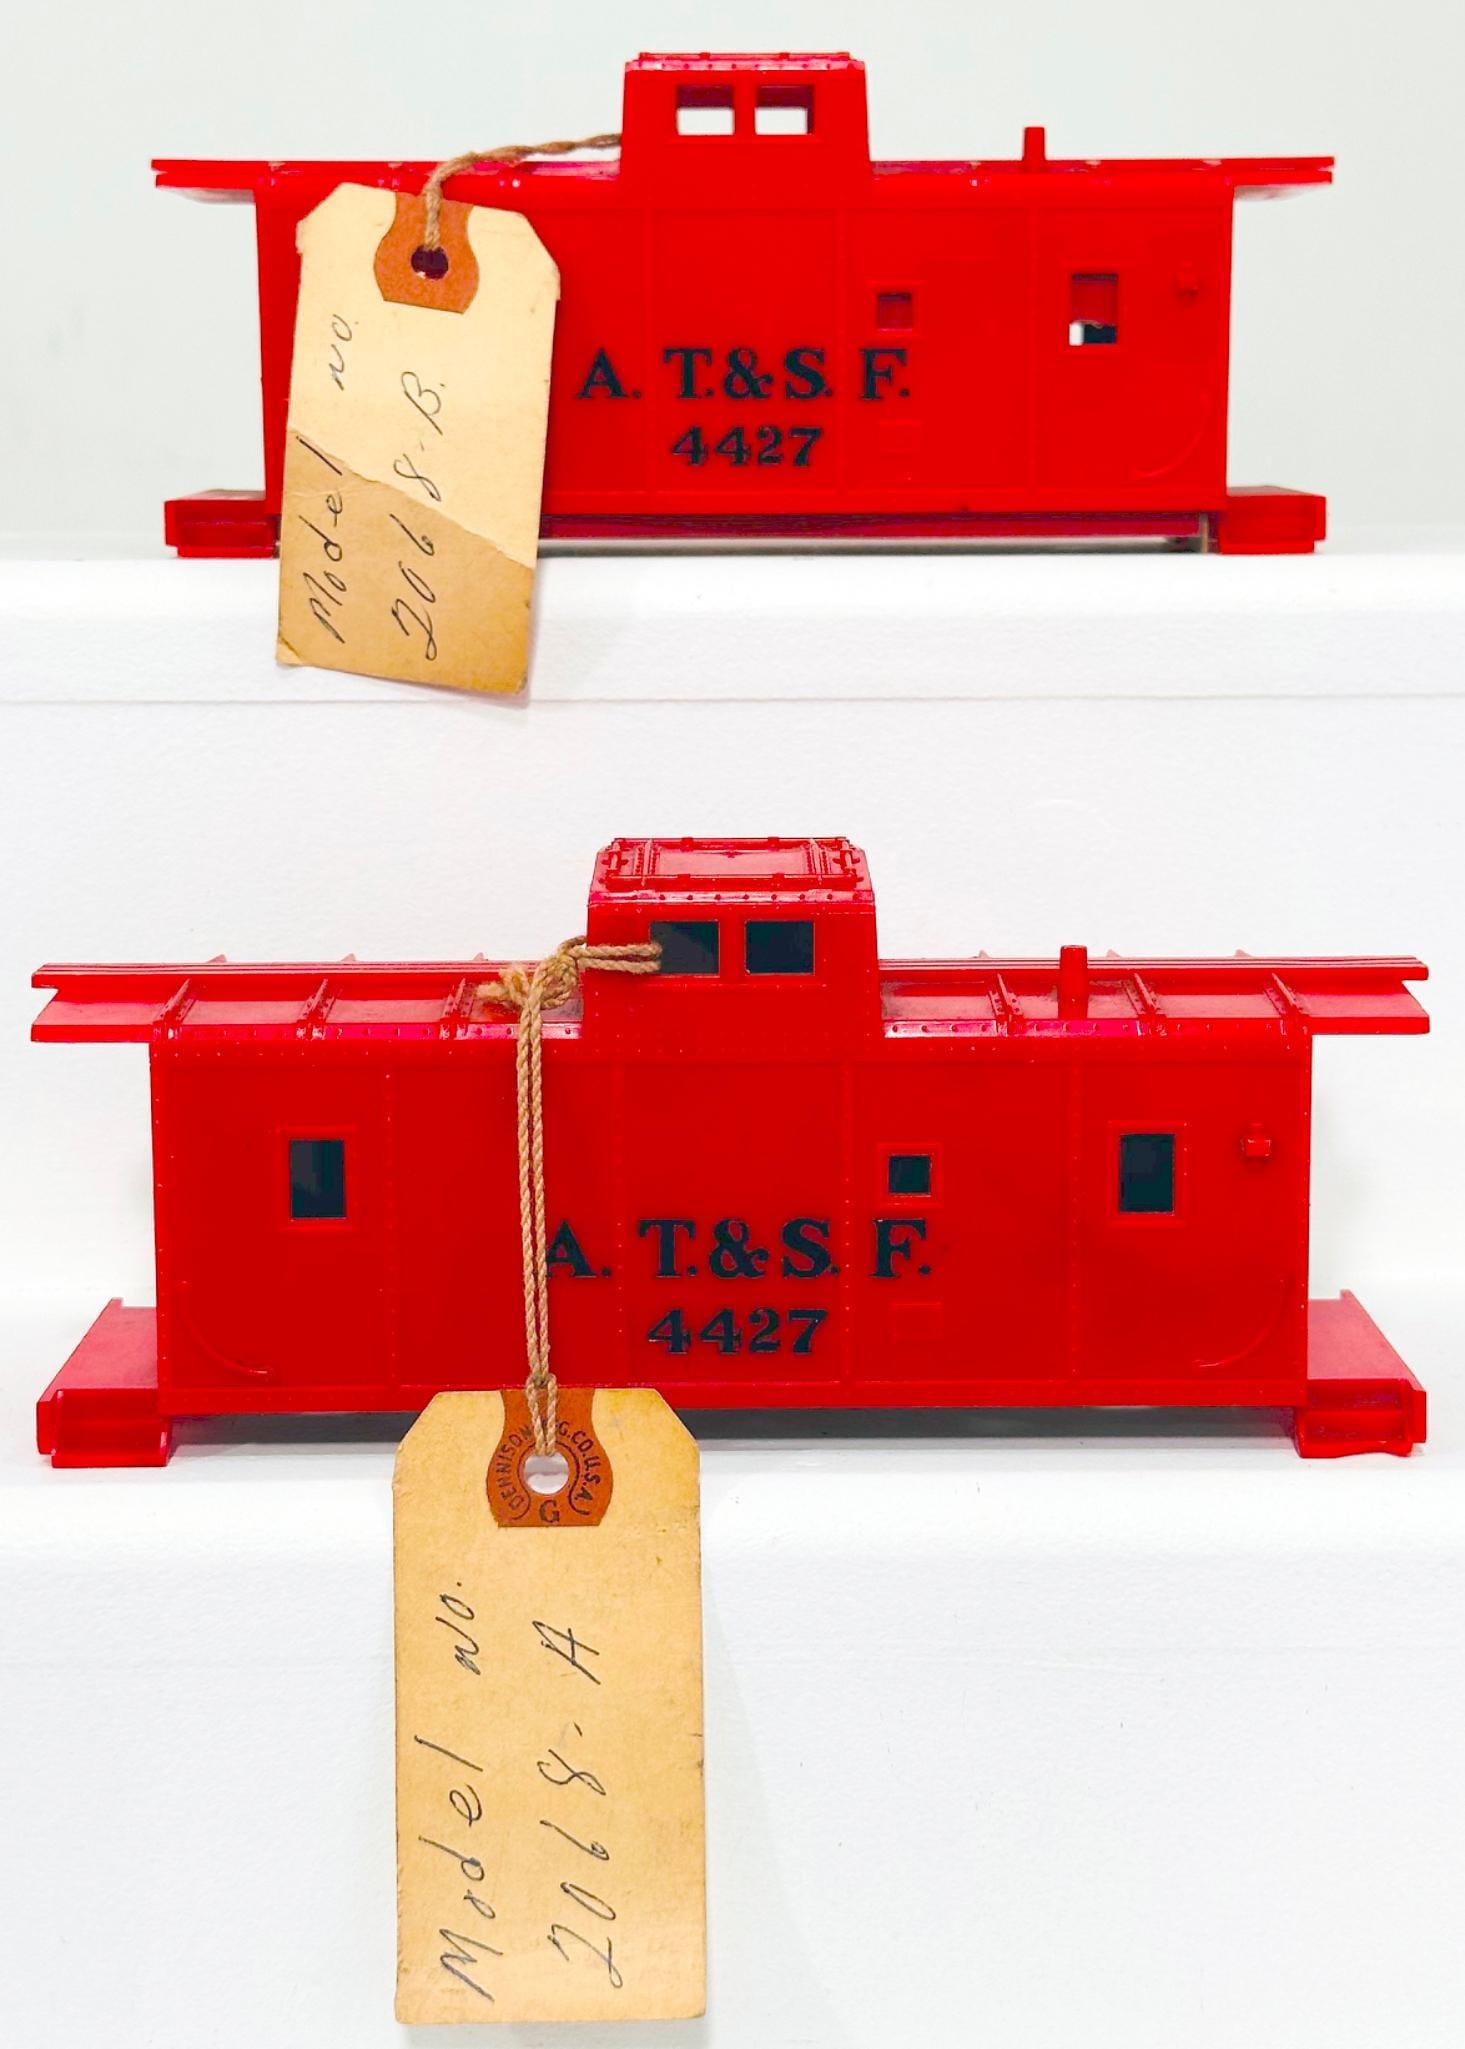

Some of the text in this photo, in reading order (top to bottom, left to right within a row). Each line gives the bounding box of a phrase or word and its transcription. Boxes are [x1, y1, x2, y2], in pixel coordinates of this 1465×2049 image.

[575, 346, 642, 400] A.
[859, 347, 911, 401] F.
[671, 425, 823, 467] 4427
[296, 433, 347, 644] Model
[545, 1219, 612, 1279] A.
[868, 1217, 931, 1279] F.
[647, 1308, 828, 1355] 4427
[496, 1424, 534, 1510] DENNISON
[539, 1499, 560, 1523] G
[414, 1733, 503, 2005] Model
